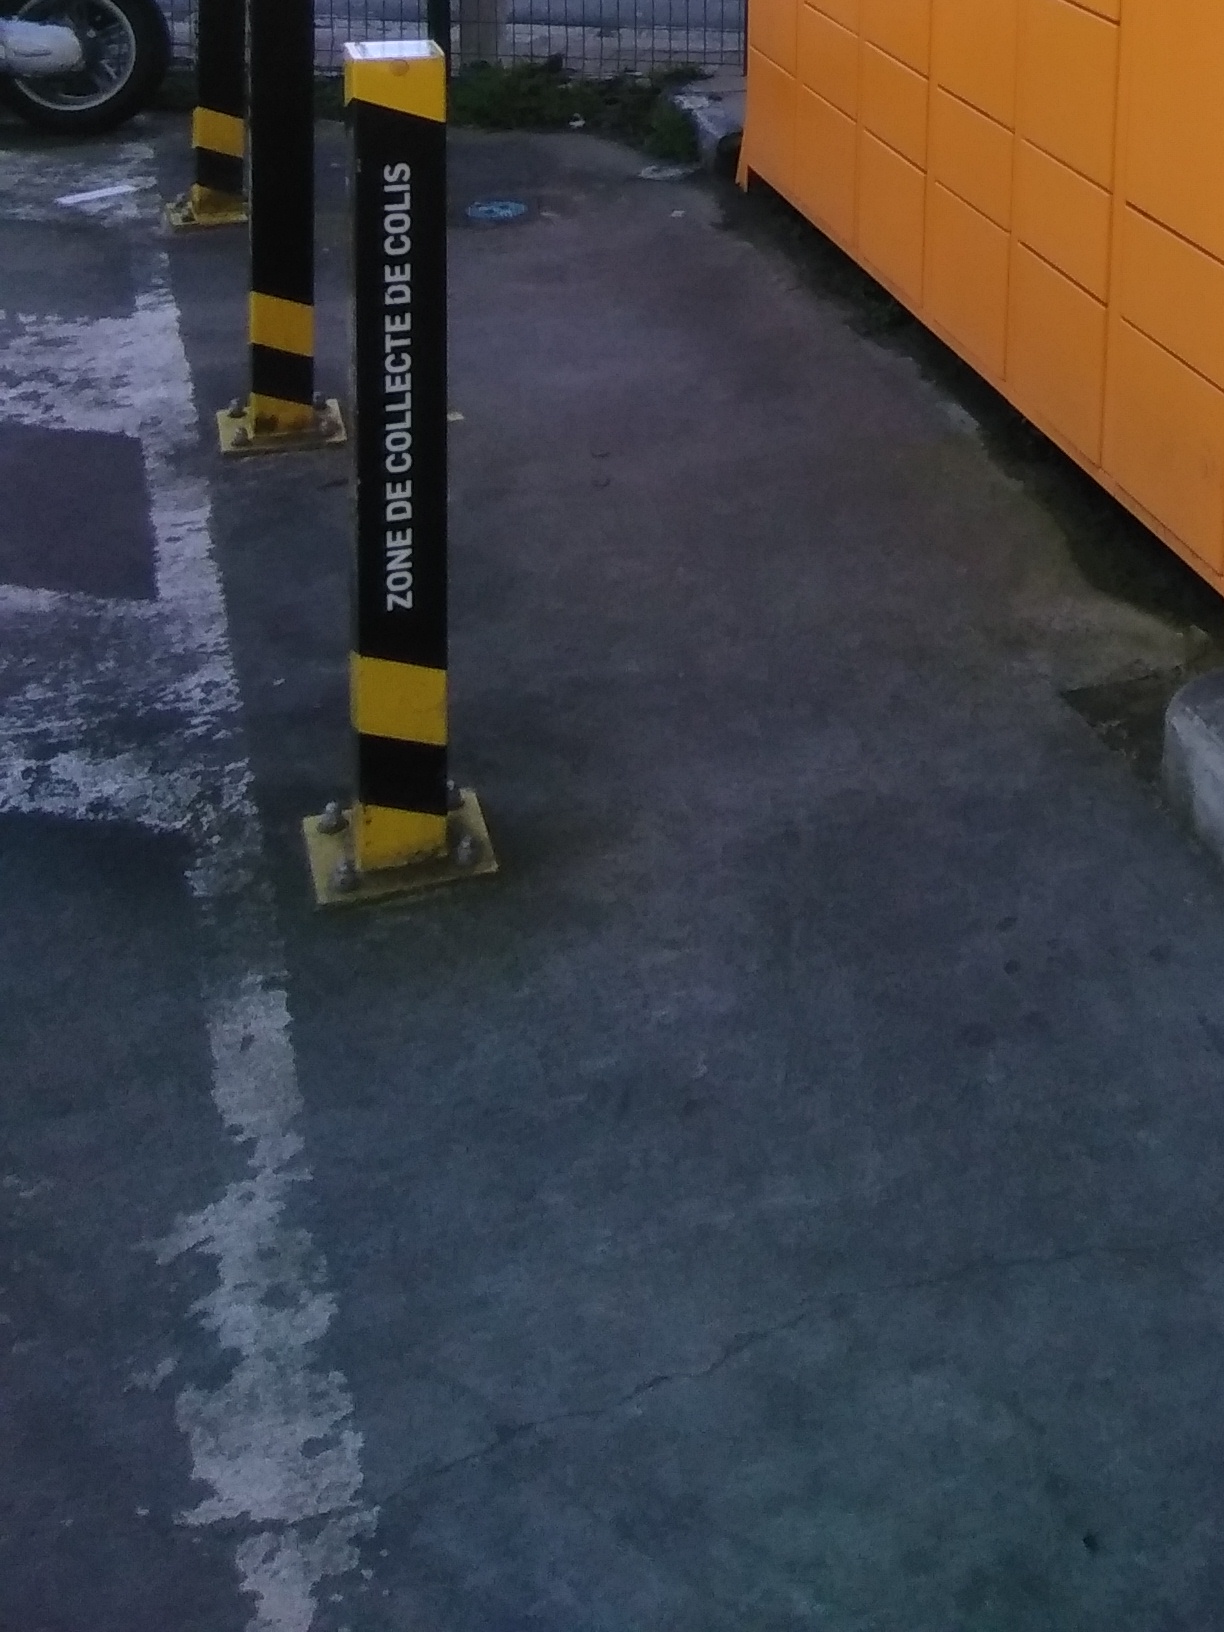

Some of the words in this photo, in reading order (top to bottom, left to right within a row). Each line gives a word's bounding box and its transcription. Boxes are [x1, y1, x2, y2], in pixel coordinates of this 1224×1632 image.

[384, 162, 411, 256] COLIS
[385, 263, 411, 305] DE
[385, 312, 412, 474] COLLECTE
[385, 479, 413, 522] DE
[386, 528, 413, 612] ZONE
